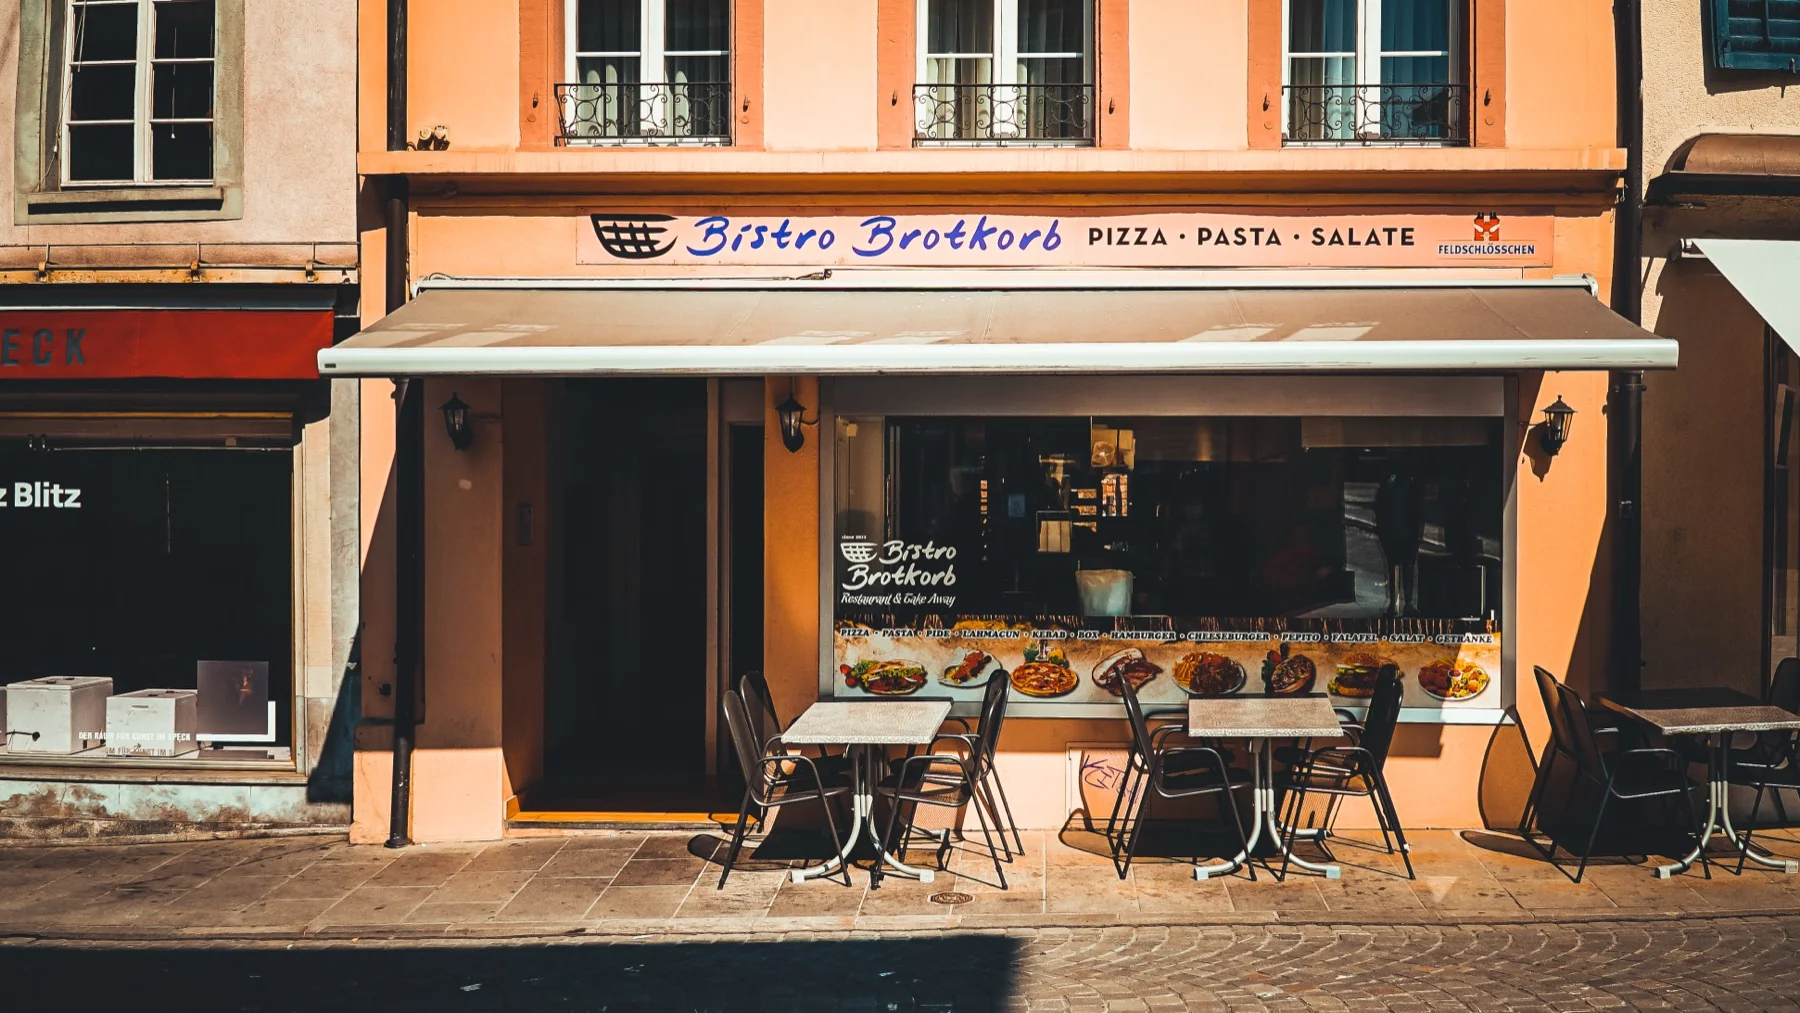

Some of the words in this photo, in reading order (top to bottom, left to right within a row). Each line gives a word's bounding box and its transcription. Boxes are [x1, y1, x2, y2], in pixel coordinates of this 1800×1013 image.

[686, 216, 835, 257] Bistro
[852, 215, 1062, 257] Brotkorb
[1088, 227, 1168, 246] PIZZA
[1198, 227, 1283, 246] PASTA
[1311, 227, 1415, 246] SALATE
[1437, 241, 1536, 255] FELDSCHLÖSSCHEN
[14, 481, 82, 508] Blitz
[879, 540, 957, 564] Bistro
[842, 563, 957, 590] Brotkorb
[841, 592, 892, 605] Restaurant
[927, 593, 956, 608] Away
[840, 628, 870, 637] PIZZA
[881, 628, 915, 638] PASTA
[925, 629, 951, 638] PIDE
[962, 629, 1020, 639] LAHMACUN
[1031, 630, 1067, 640] KEBAB
[1077, 631, 1099, 640] BOX
[1110, 631, 1177, 640] HAMBURGER
[1281, 632, 1321, 642] PEPITO
[1330, 633, 1378, 643] FALAFEL
[1389, 634, 1424, 643] SALAT
[78, 731, 92, 740] DER
